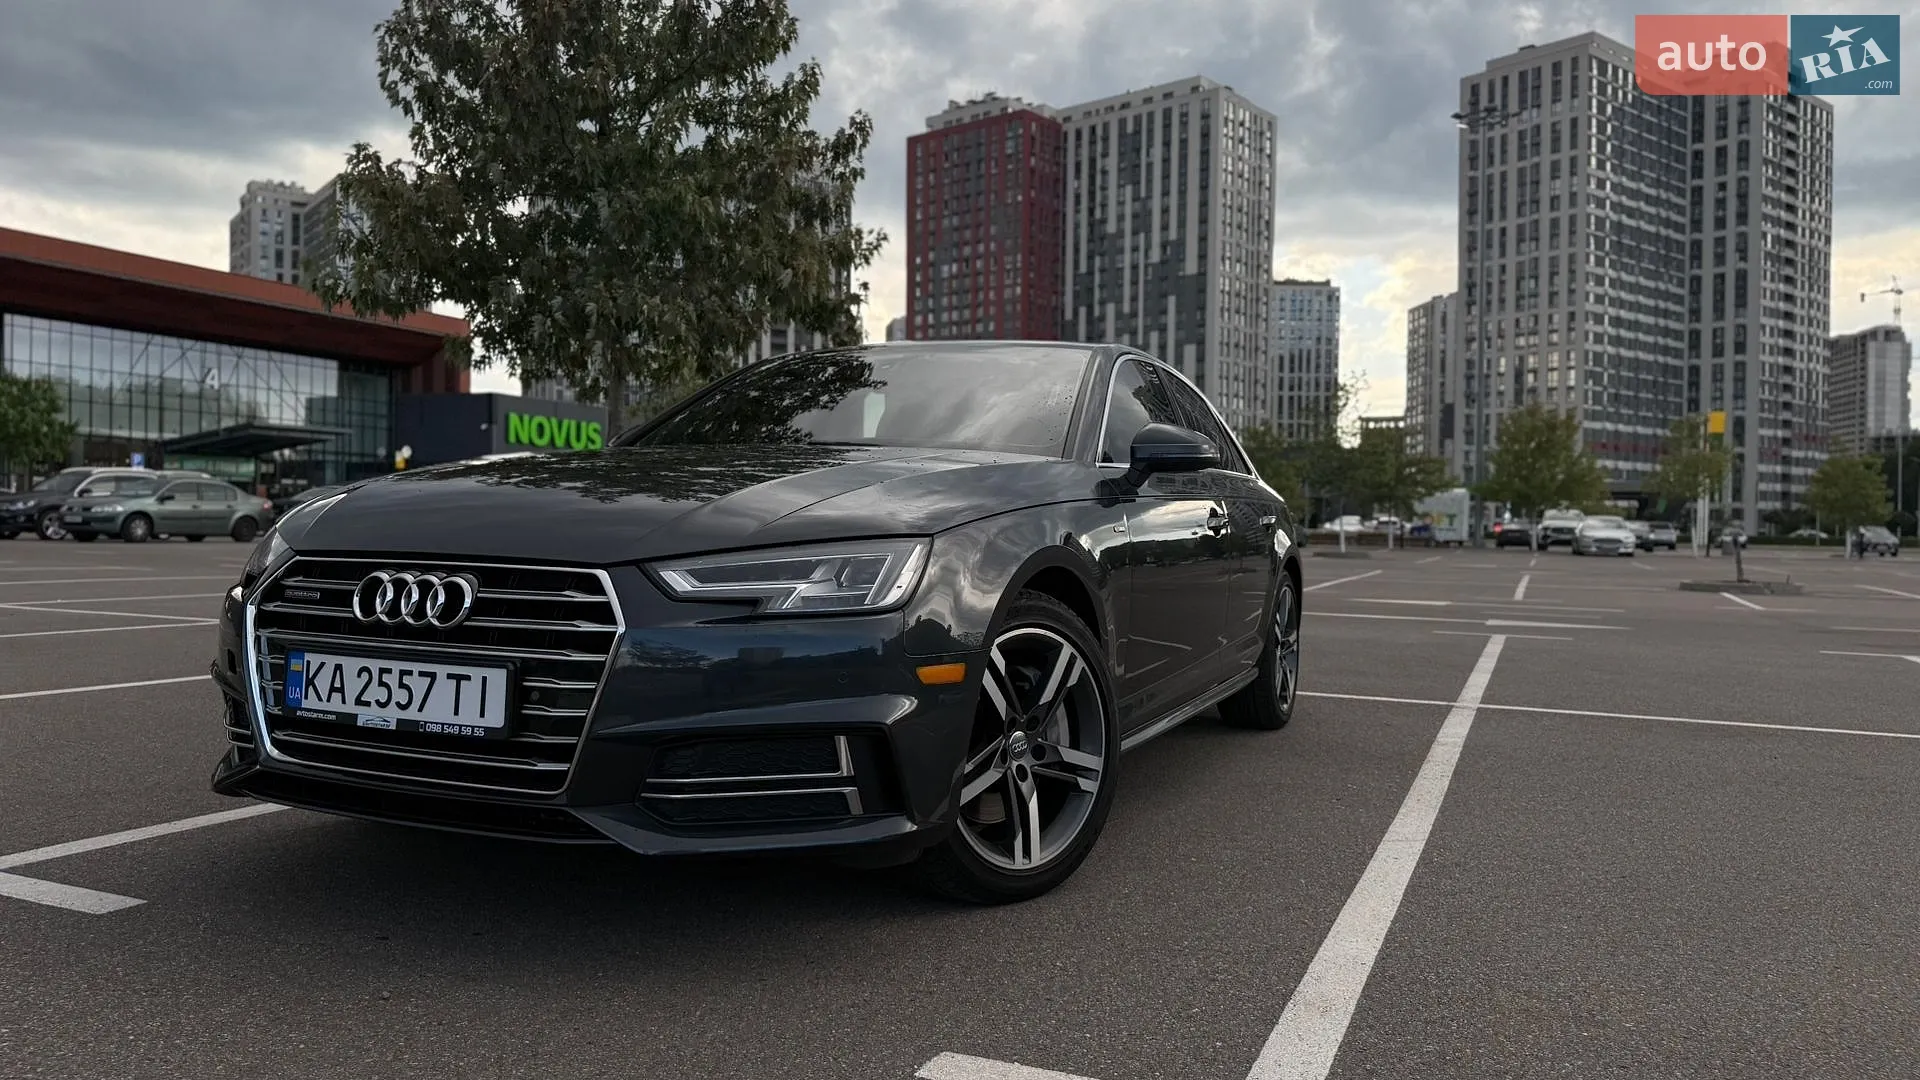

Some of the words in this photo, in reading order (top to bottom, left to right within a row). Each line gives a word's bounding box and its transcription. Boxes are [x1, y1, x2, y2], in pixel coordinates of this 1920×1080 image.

[508, 411, 602, 451] NOVUS
[288, 685, 301, 699] UA
[303, 659, 347, 705] KA
[354, 665, 438, 713] 2557
[446, 672, 488, 719] TI
[425, 722, 442, 733] 098
[443, 724, 459, 734] 549
[460, 726, 472, 735] 59
[473, 727, 485, 737] 55
